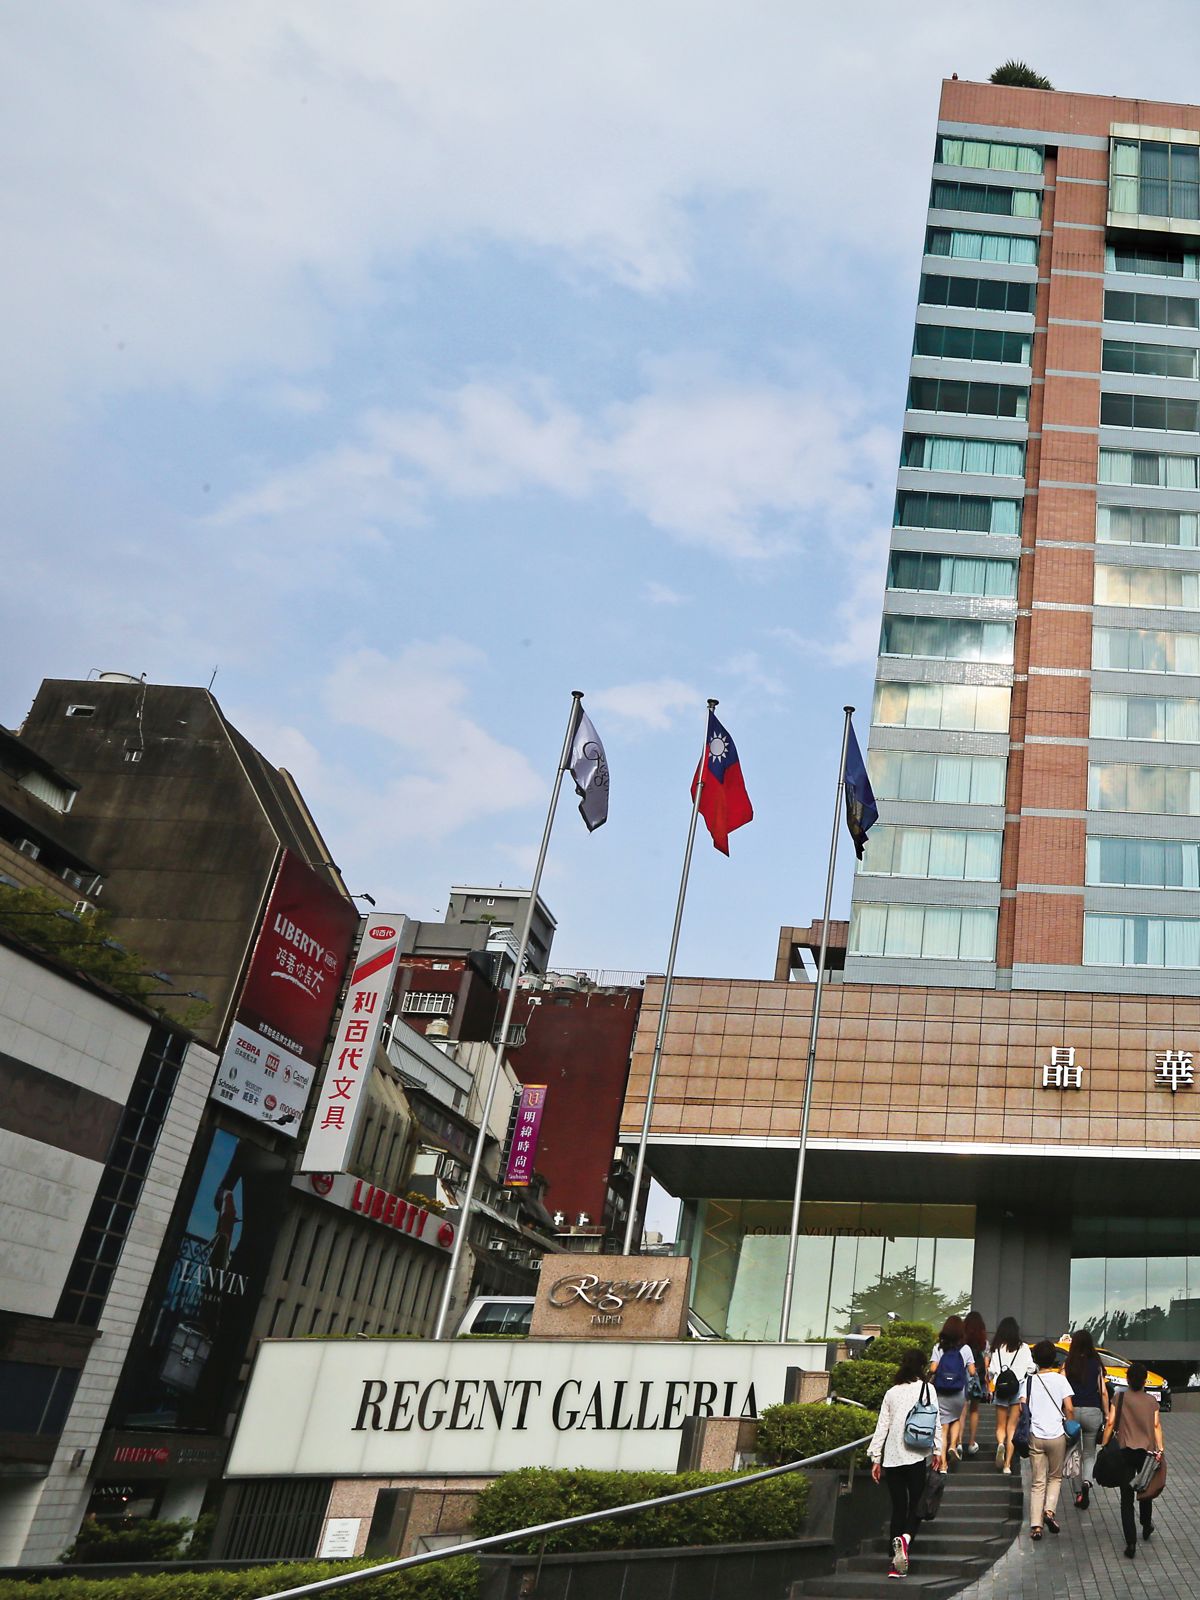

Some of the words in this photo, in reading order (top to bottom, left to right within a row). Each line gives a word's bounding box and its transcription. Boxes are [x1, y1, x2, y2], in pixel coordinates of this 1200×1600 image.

[274, 913, 325, 962] LIBERTY
[276, 947, 325, 993] 陪著你長大
[236, 1037, 261, 1057] ZEBRA
[321, 991, 378, 1130] 利百代文具
[293, 1070, 310, 1085] Camel
[514, 1111, 536, 1168] 明緯時尚
[352, 1179, 429, 1238] LIBERTY
[180, 1260, 249, 1296] LANVIN
[550, 1273, 671, 1311] Regent
[351, 1379, 542, 1431] REGENT
[551, 1379, 759, 1431] GALLERIA
